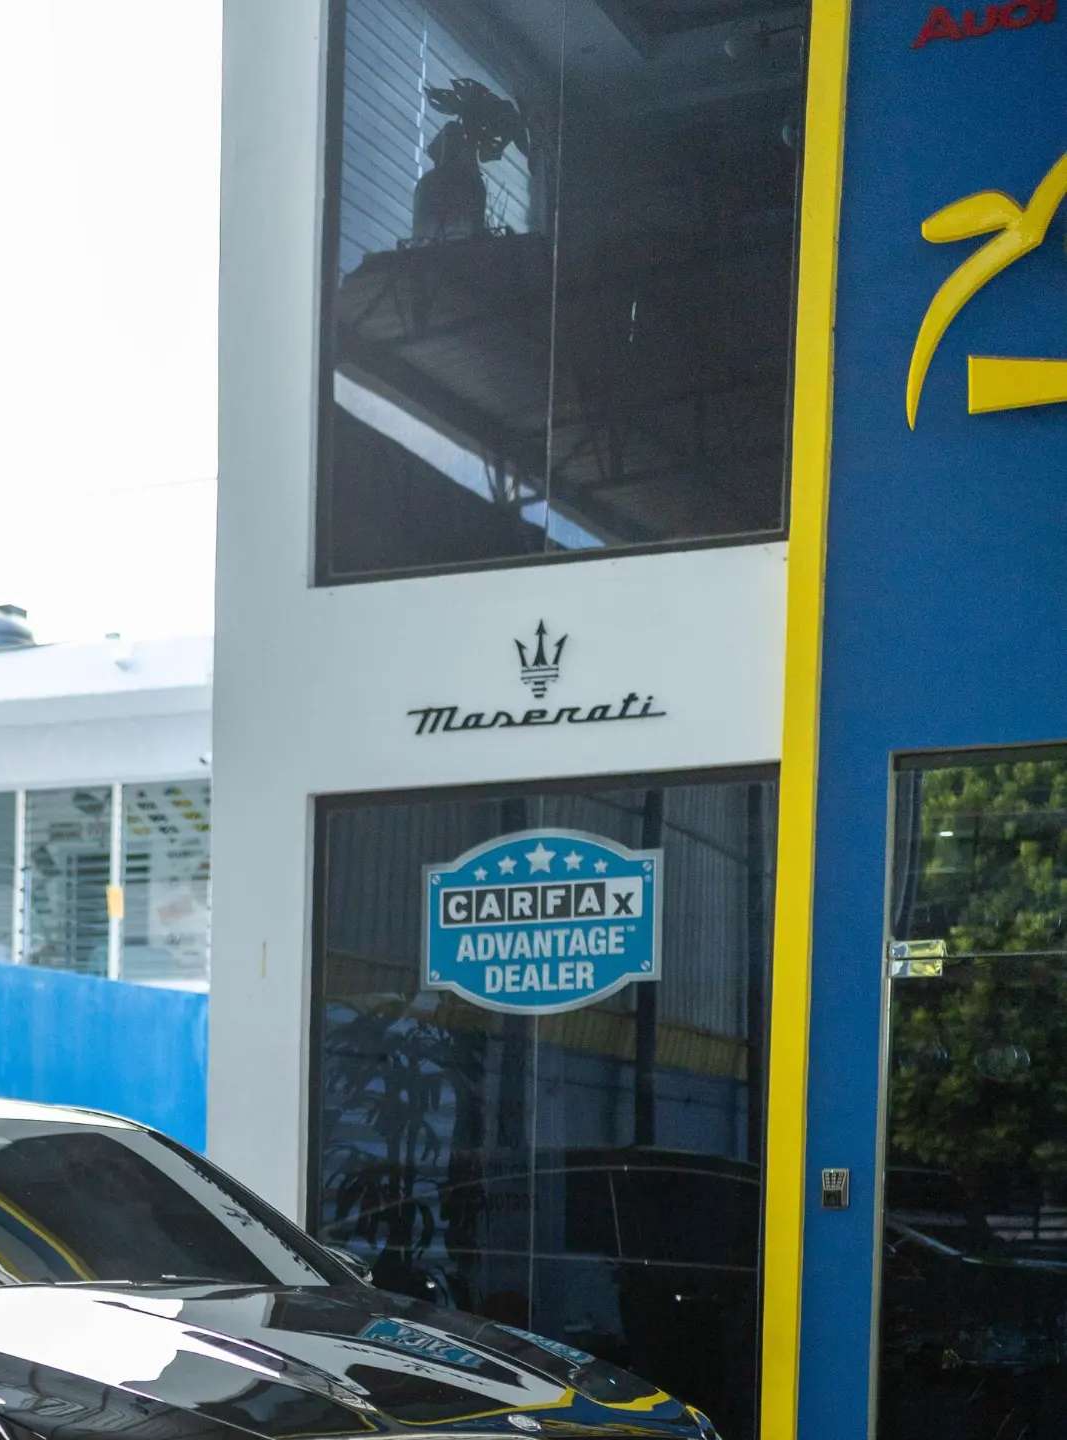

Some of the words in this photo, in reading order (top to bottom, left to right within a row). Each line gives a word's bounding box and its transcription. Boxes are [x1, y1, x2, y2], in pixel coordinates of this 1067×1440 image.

[406, 691, 667, 736] Maserati
[447, 885, 634, 923] CARFAX
[485, 961, 595, 994] DEALER
